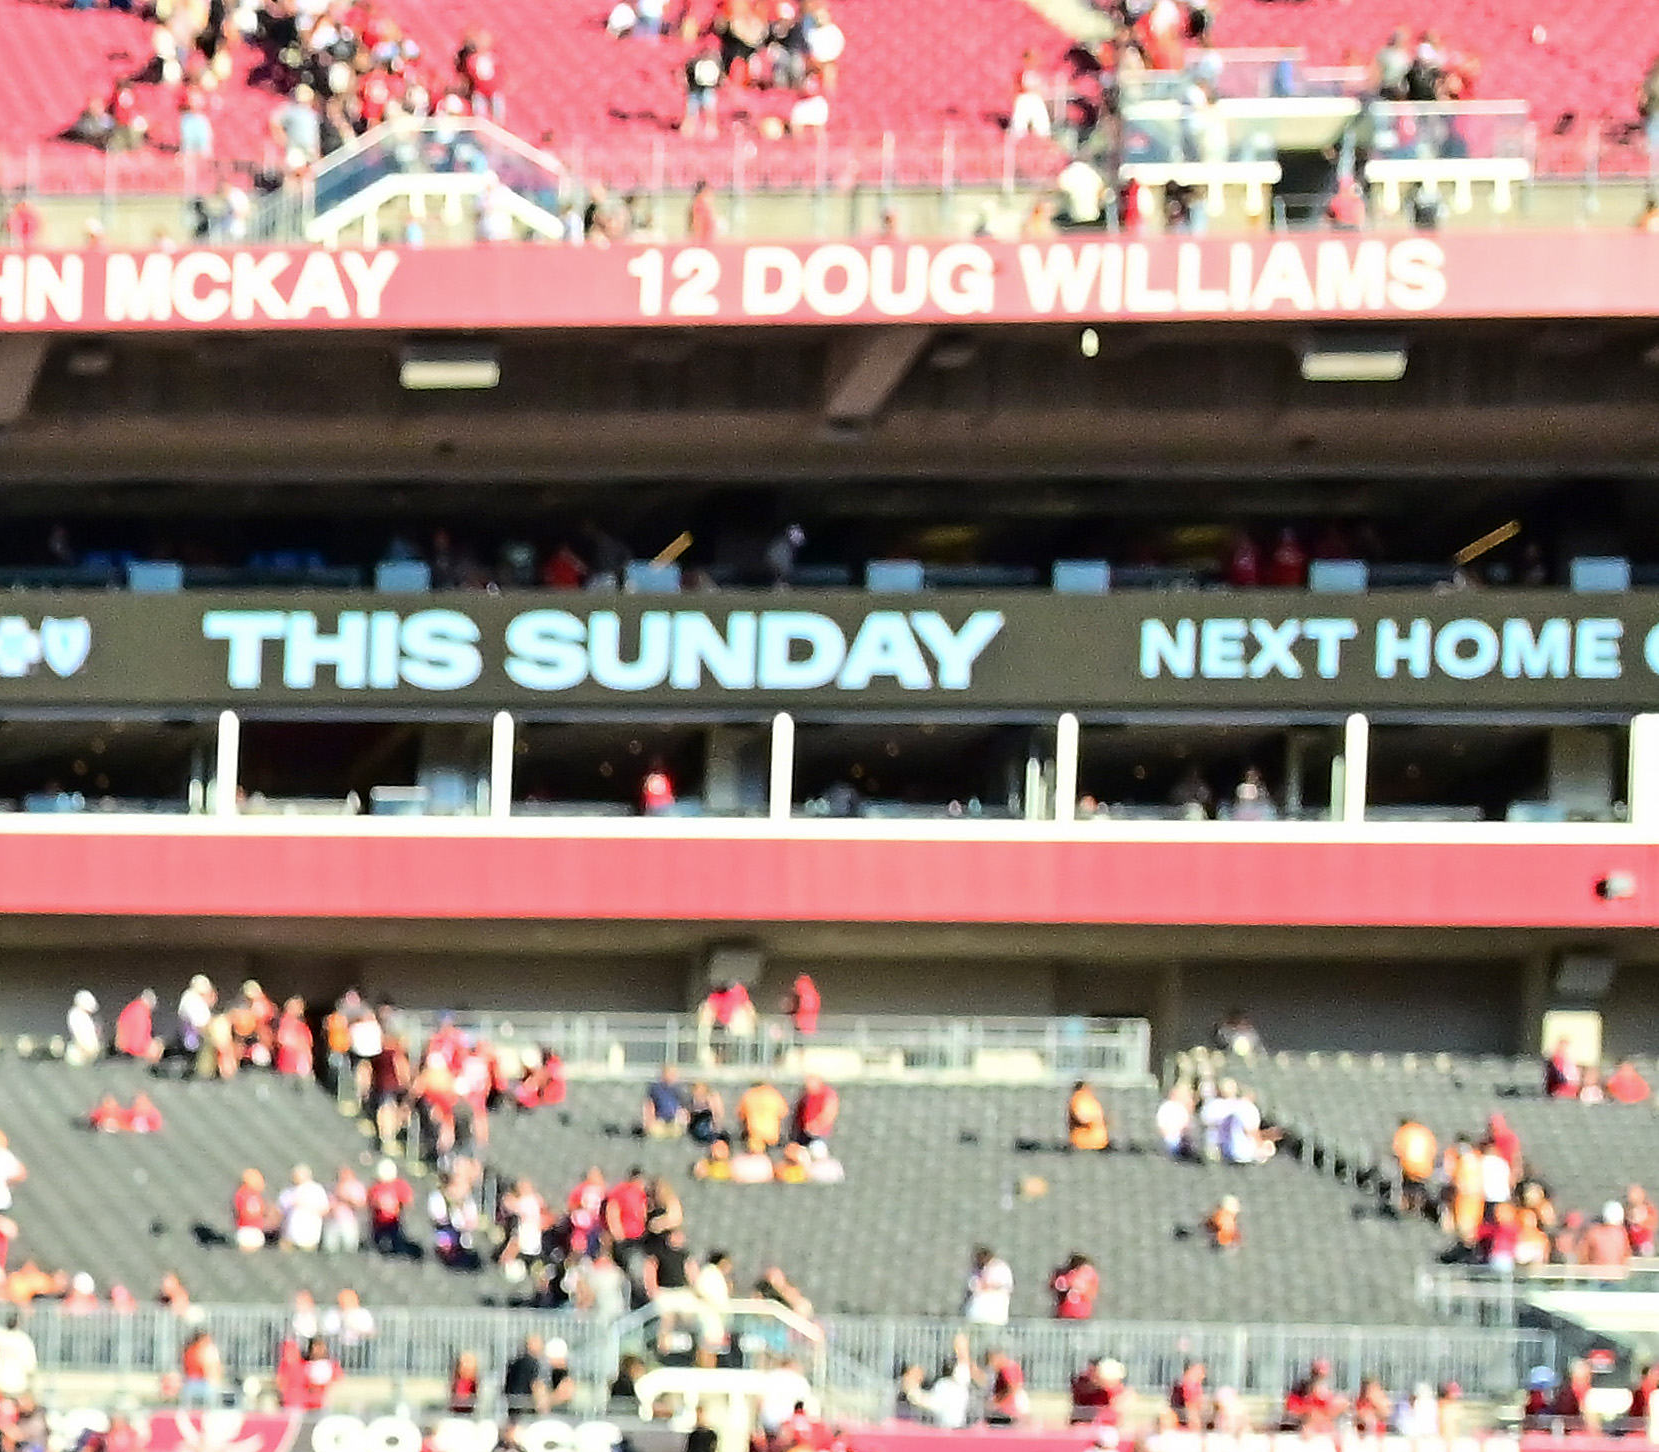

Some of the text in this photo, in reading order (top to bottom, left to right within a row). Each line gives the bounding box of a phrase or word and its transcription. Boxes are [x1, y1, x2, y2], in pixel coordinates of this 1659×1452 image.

[103, 250, 399, 322] MCKAY
[628, 240, 1448, 318] 12 DOUG WILLIAMS
[203, 609, 1005, 691] THIS SUNDAY
[1140, 617, 1358, 679] NEXT
[1375, 617, 1623, 679] HOME
